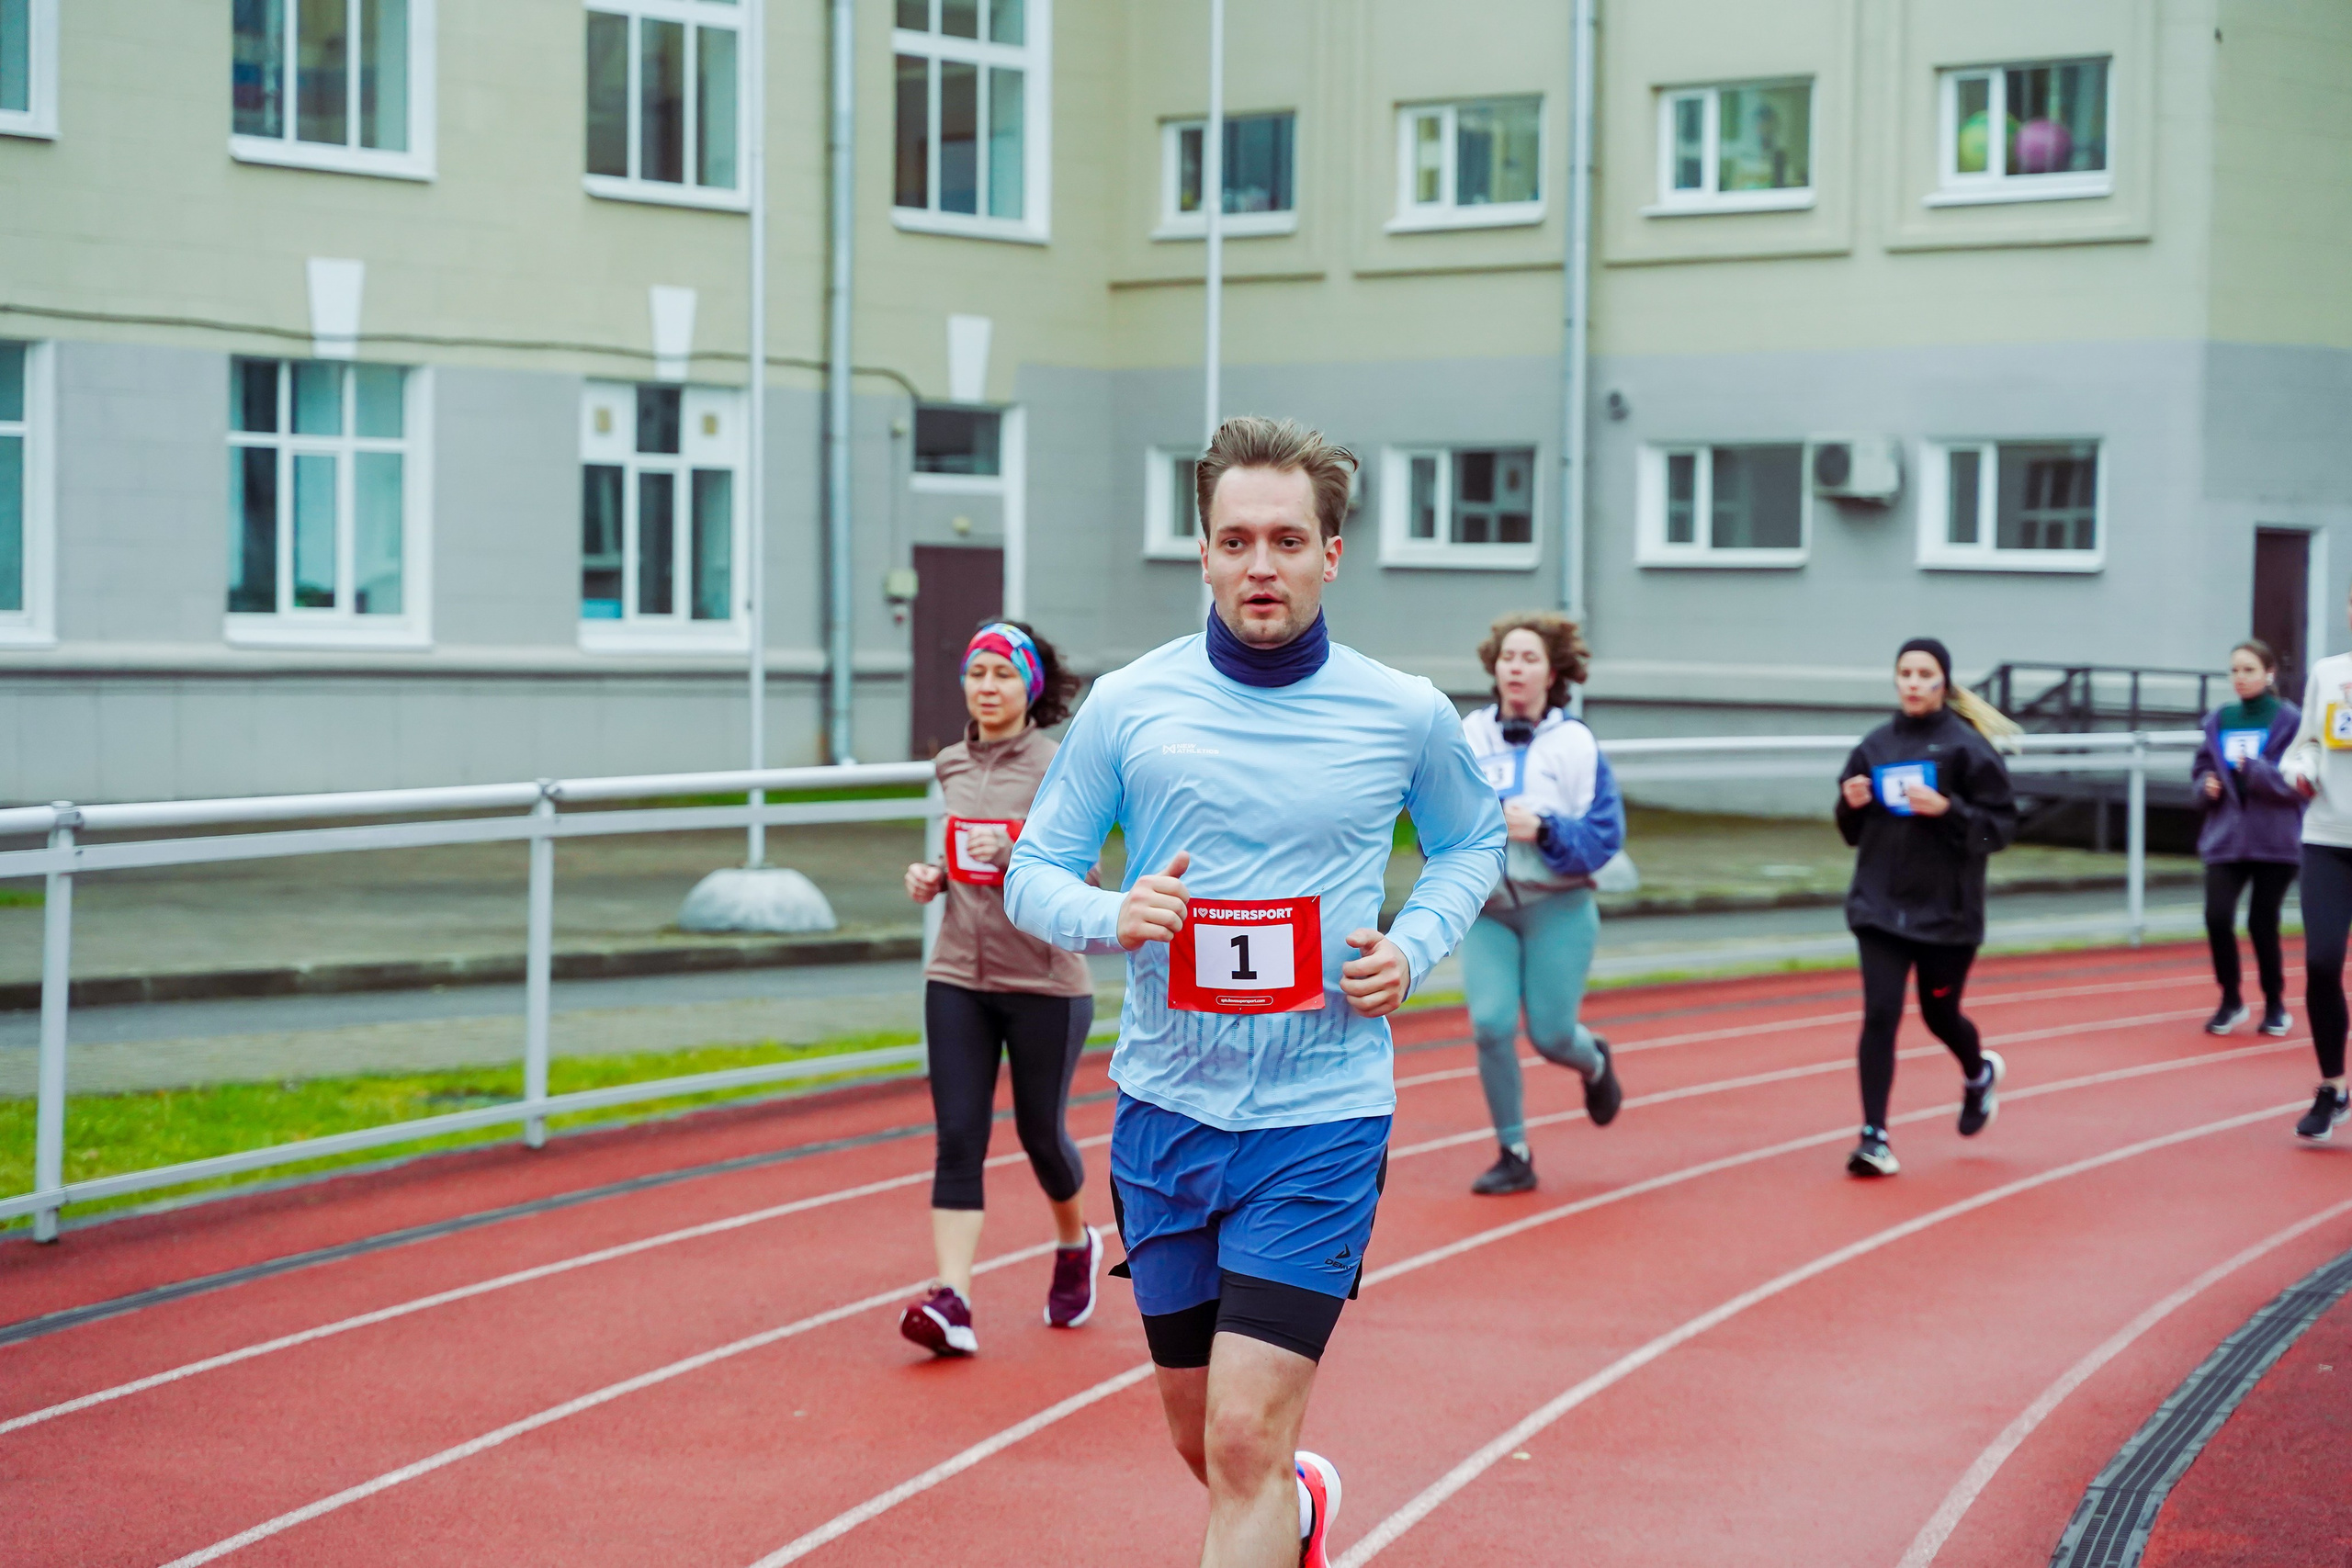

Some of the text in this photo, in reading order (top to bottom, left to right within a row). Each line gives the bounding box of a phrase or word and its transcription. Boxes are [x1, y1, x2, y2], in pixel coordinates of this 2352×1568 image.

[1193, 907, 1293, 919] I SUPERSPORT
[1230, 934, 1258, 980] 1
